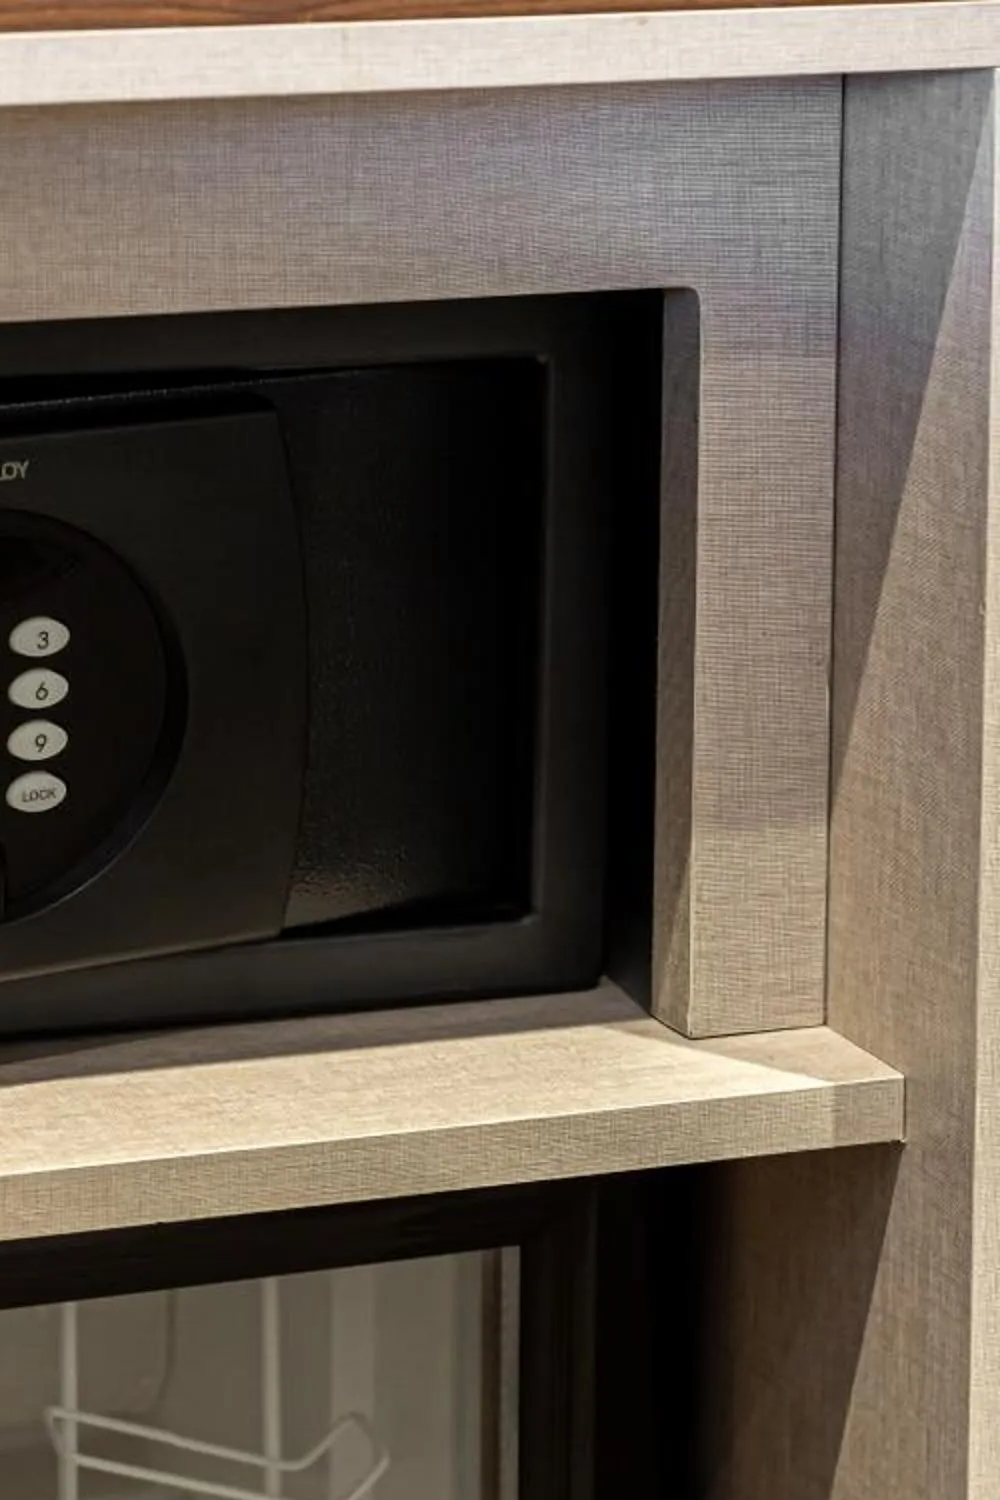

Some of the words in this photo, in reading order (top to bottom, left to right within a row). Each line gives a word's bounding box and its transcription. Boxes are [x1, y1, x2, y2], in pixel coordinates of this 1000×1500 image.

[37, 631, 49, 649] 3
[35, 682, 49, 700] 6
[35, 734, 47, 752] 9
[22, 787, 58, 802] LOCK
